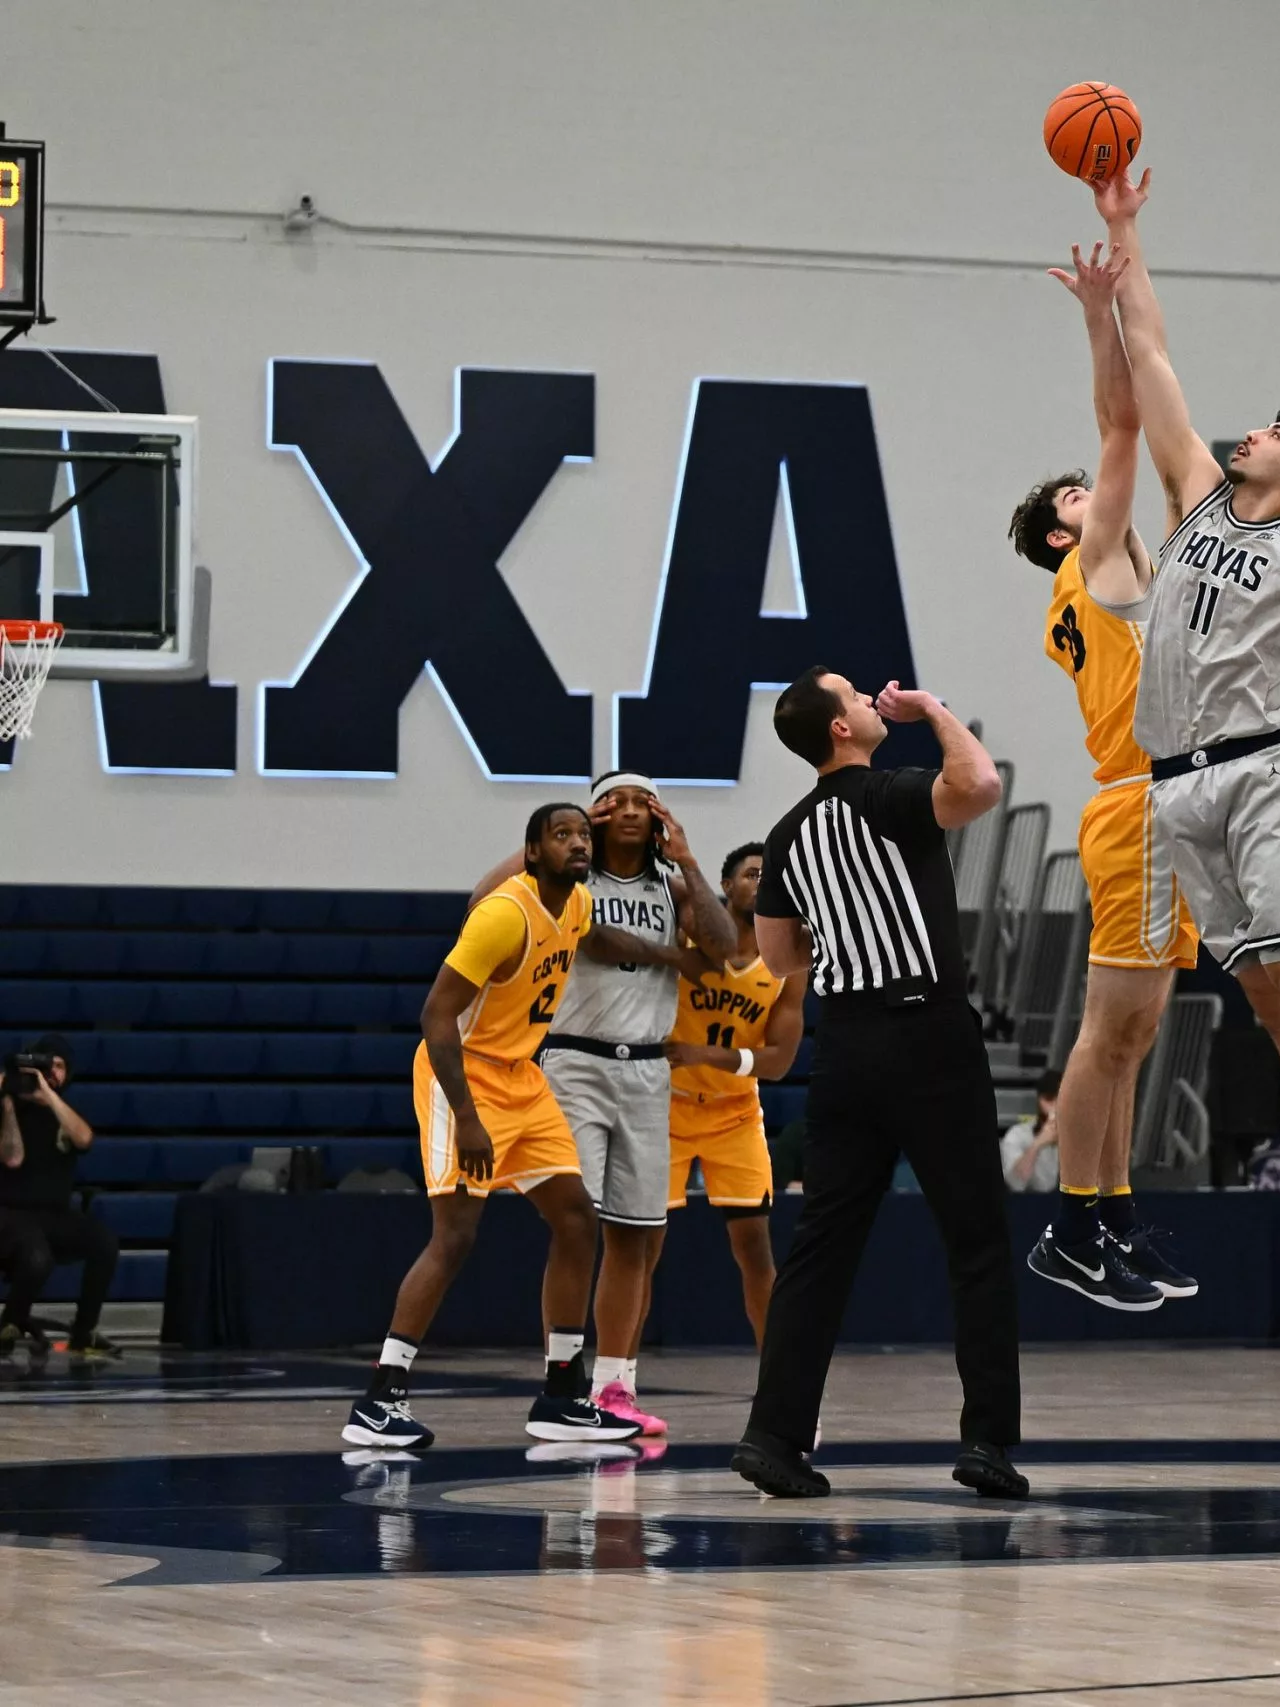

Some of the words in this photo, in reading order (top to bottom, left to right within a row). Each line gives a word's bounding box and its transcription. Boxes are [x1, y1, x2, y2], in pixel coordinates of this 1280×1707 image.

[1176, 530, 1270, 593] HOYAS
[1187, 580, 1221, 637] 11
[591, 897, 666, 933] HOYAS
[689, 987, 765, 1024] COPPIN
[706, 1021, 735, 1049] 11
